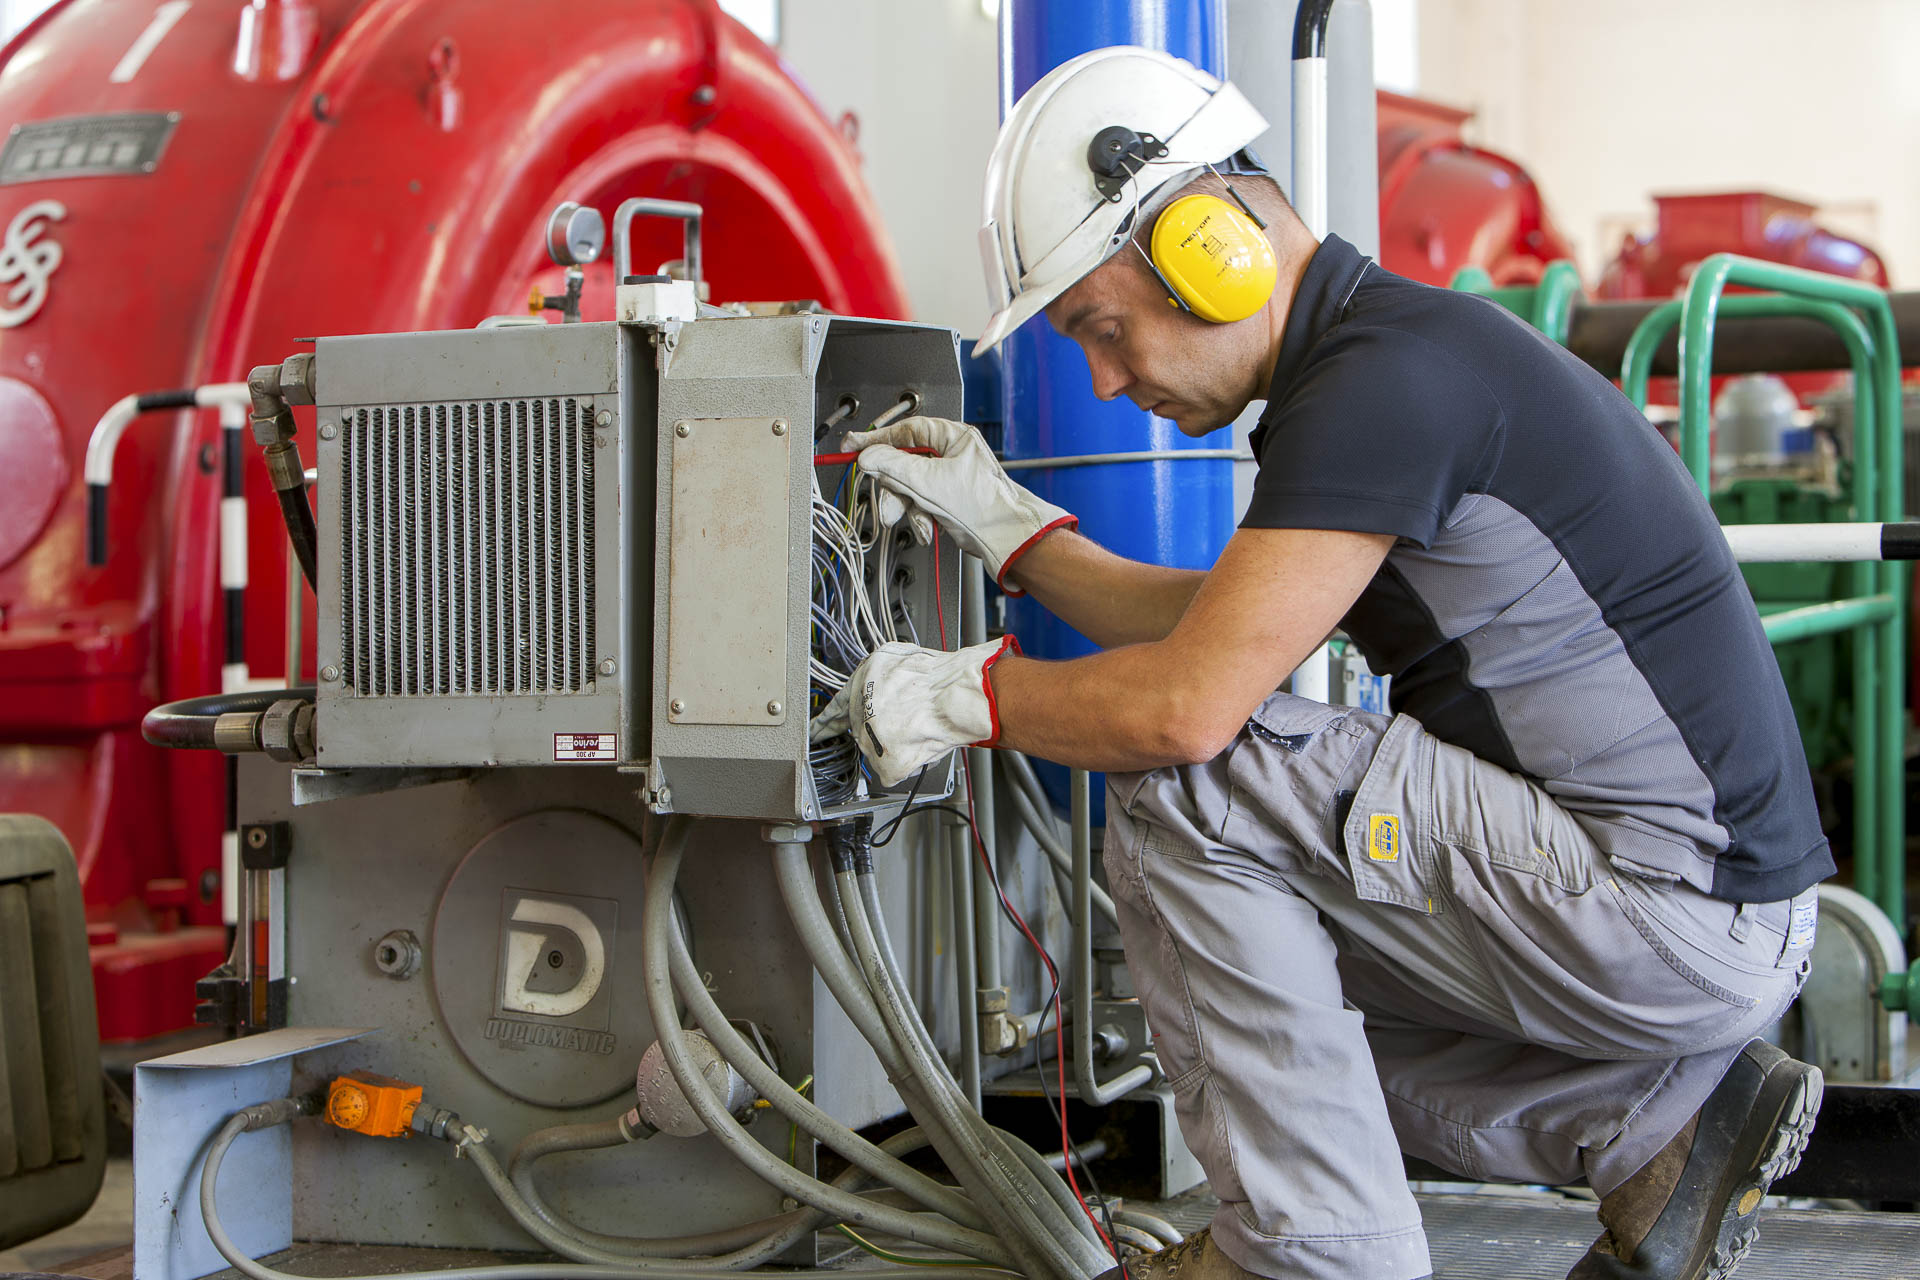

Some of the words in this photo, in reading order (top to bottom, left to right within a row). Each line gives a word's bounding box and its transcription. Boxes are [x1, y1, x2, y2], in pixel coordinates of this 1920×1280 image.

[1180, 215, 1211, 248] PELTOR
[573, 739, 599, 749] sesino
[502, 898, 605, 1017] D
[484, 1018, 617, 1056] DUPLOMATIC
